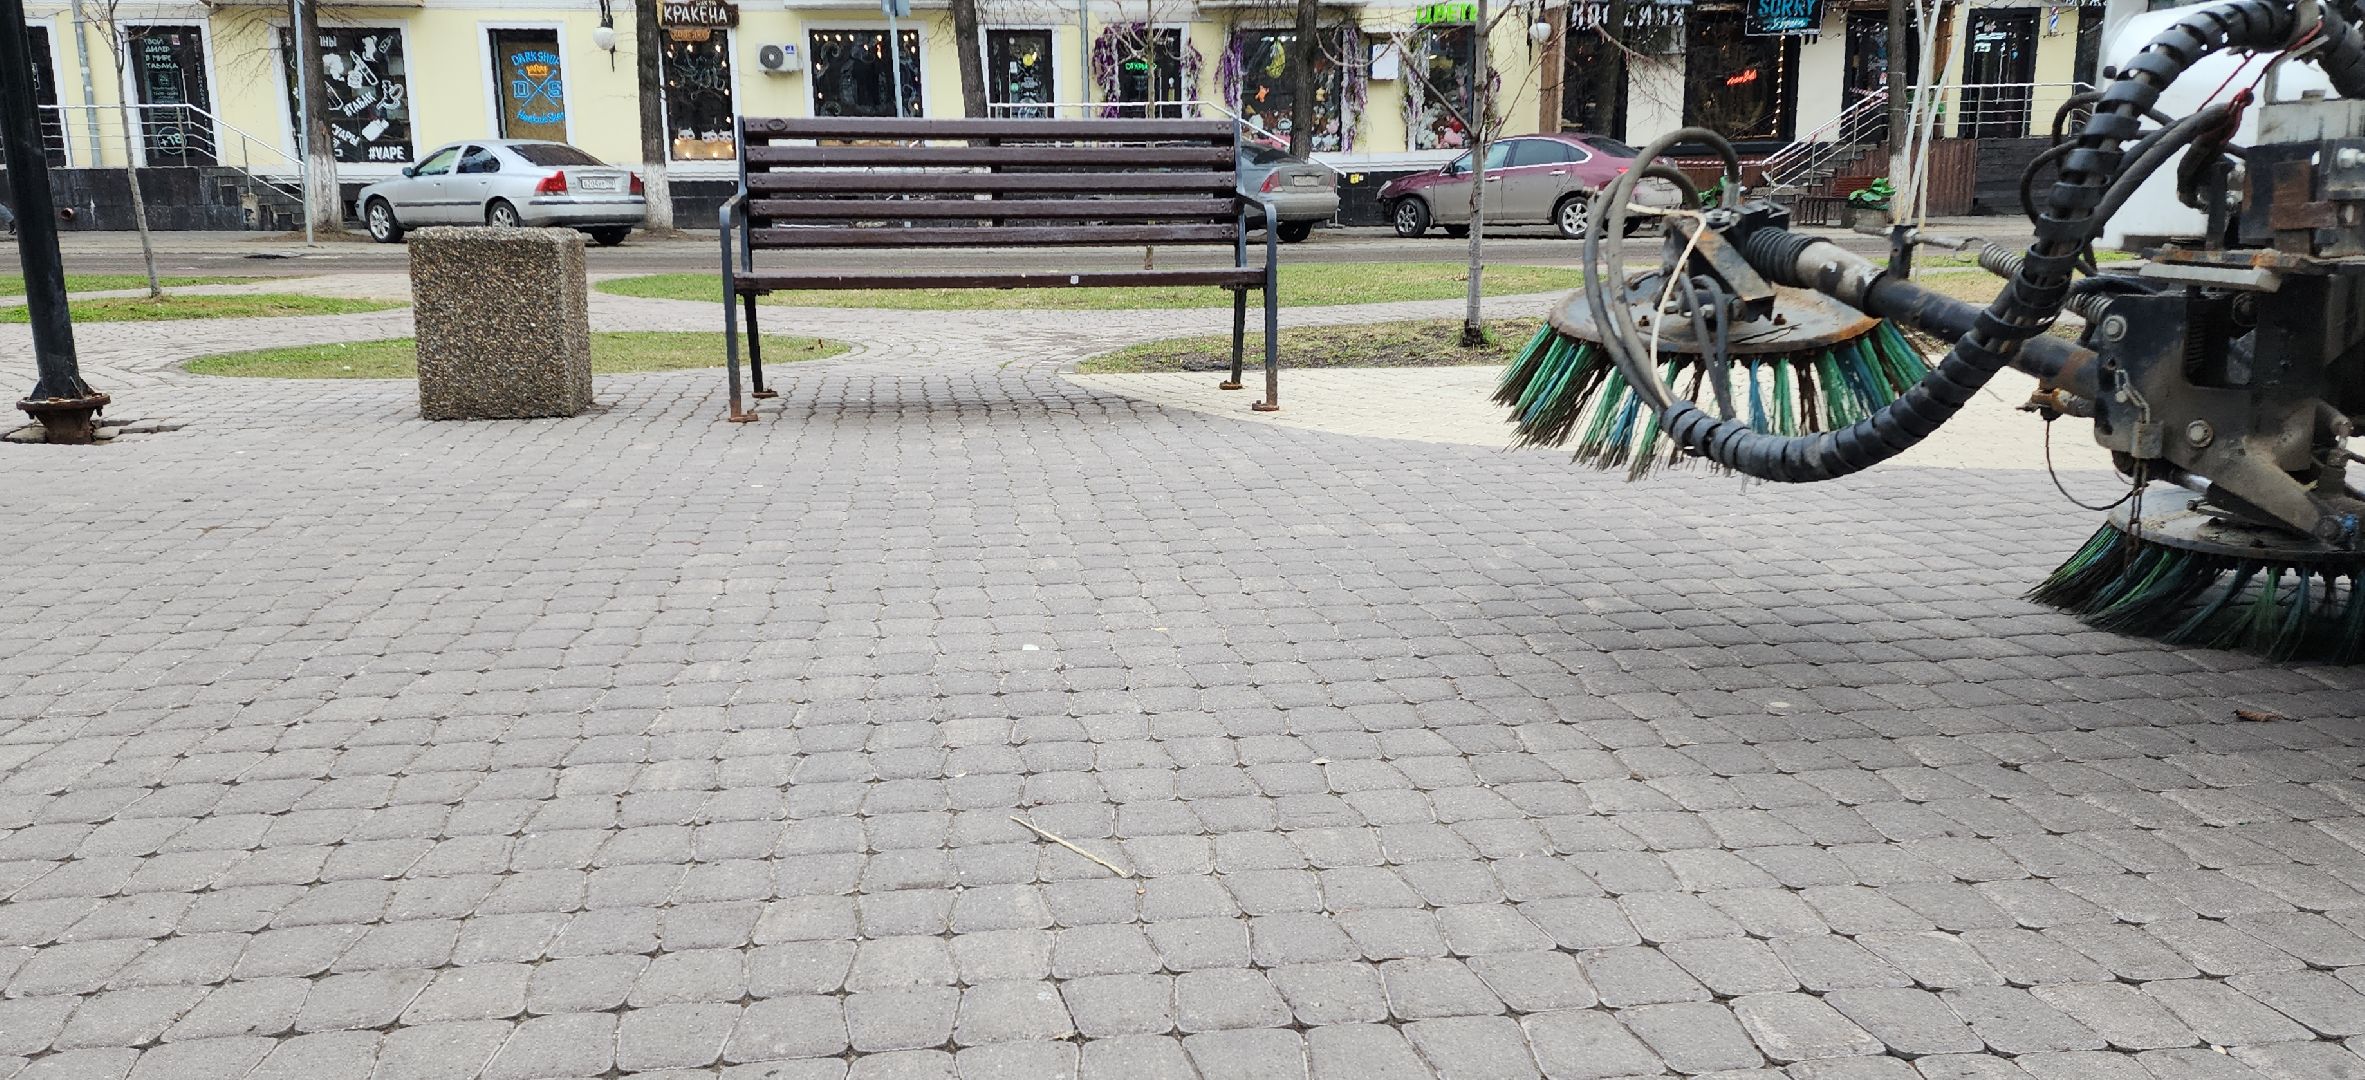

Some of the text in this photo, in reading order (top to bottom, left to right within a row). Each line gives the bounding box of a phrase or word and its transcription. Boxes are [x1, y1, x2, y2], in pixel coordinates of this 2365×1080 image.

[664, 5, 728, 24] КРАКЕНА
[145, 45, 170, 53] ДИЛЕР
[1125, 62, 1157, 70] ОТКРЫО
[342, 91, 377, 117] #ТАБАК
[368, 146, 405, 160] #VAPE
